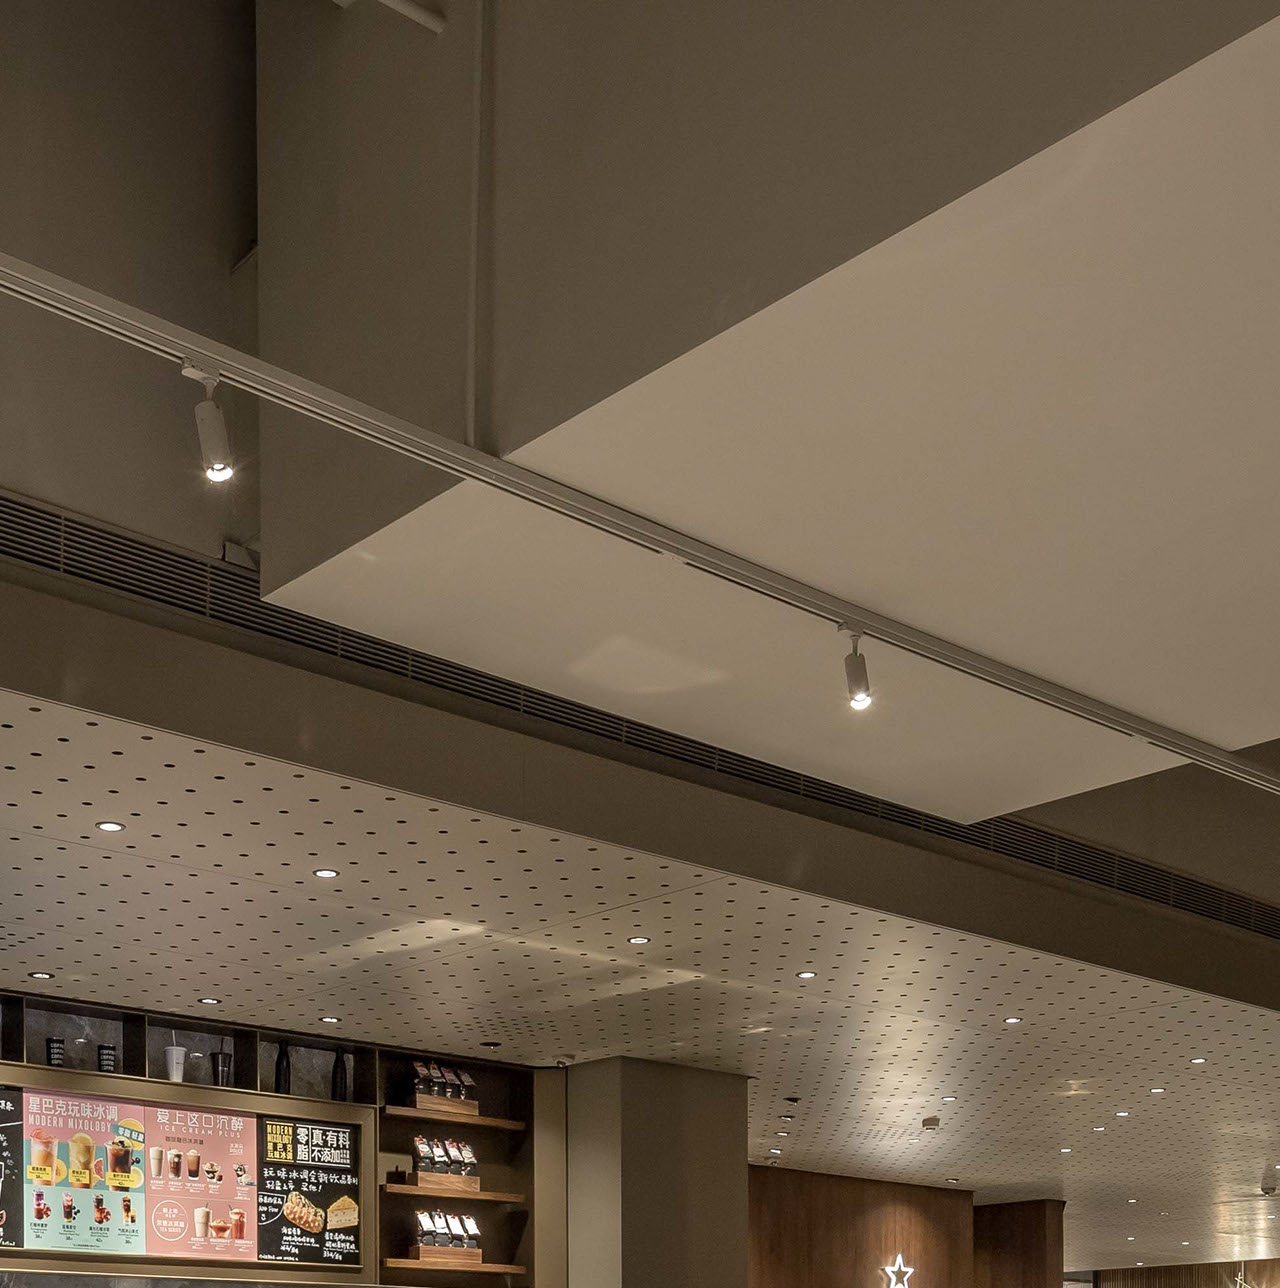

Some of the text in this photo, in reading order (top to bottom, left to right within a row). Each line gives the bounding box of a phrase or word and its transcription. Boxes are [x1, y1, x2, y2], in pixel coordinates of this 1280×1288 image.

[28, 1096, 118, 1121] 星巴克玩味冰调
[28, 1114, 112, 1132] MODERN MIXOLOGY
[156, 1108, 244, 1132] 爱上这口沉醉
[182, 1126, 213, 1136] CREAM
[266, 1124, 293, 1135] MODERN
[296, 1128, 350, 1161] 零脂 真·有料
[311, 1146, 340, 1163] 不添加
